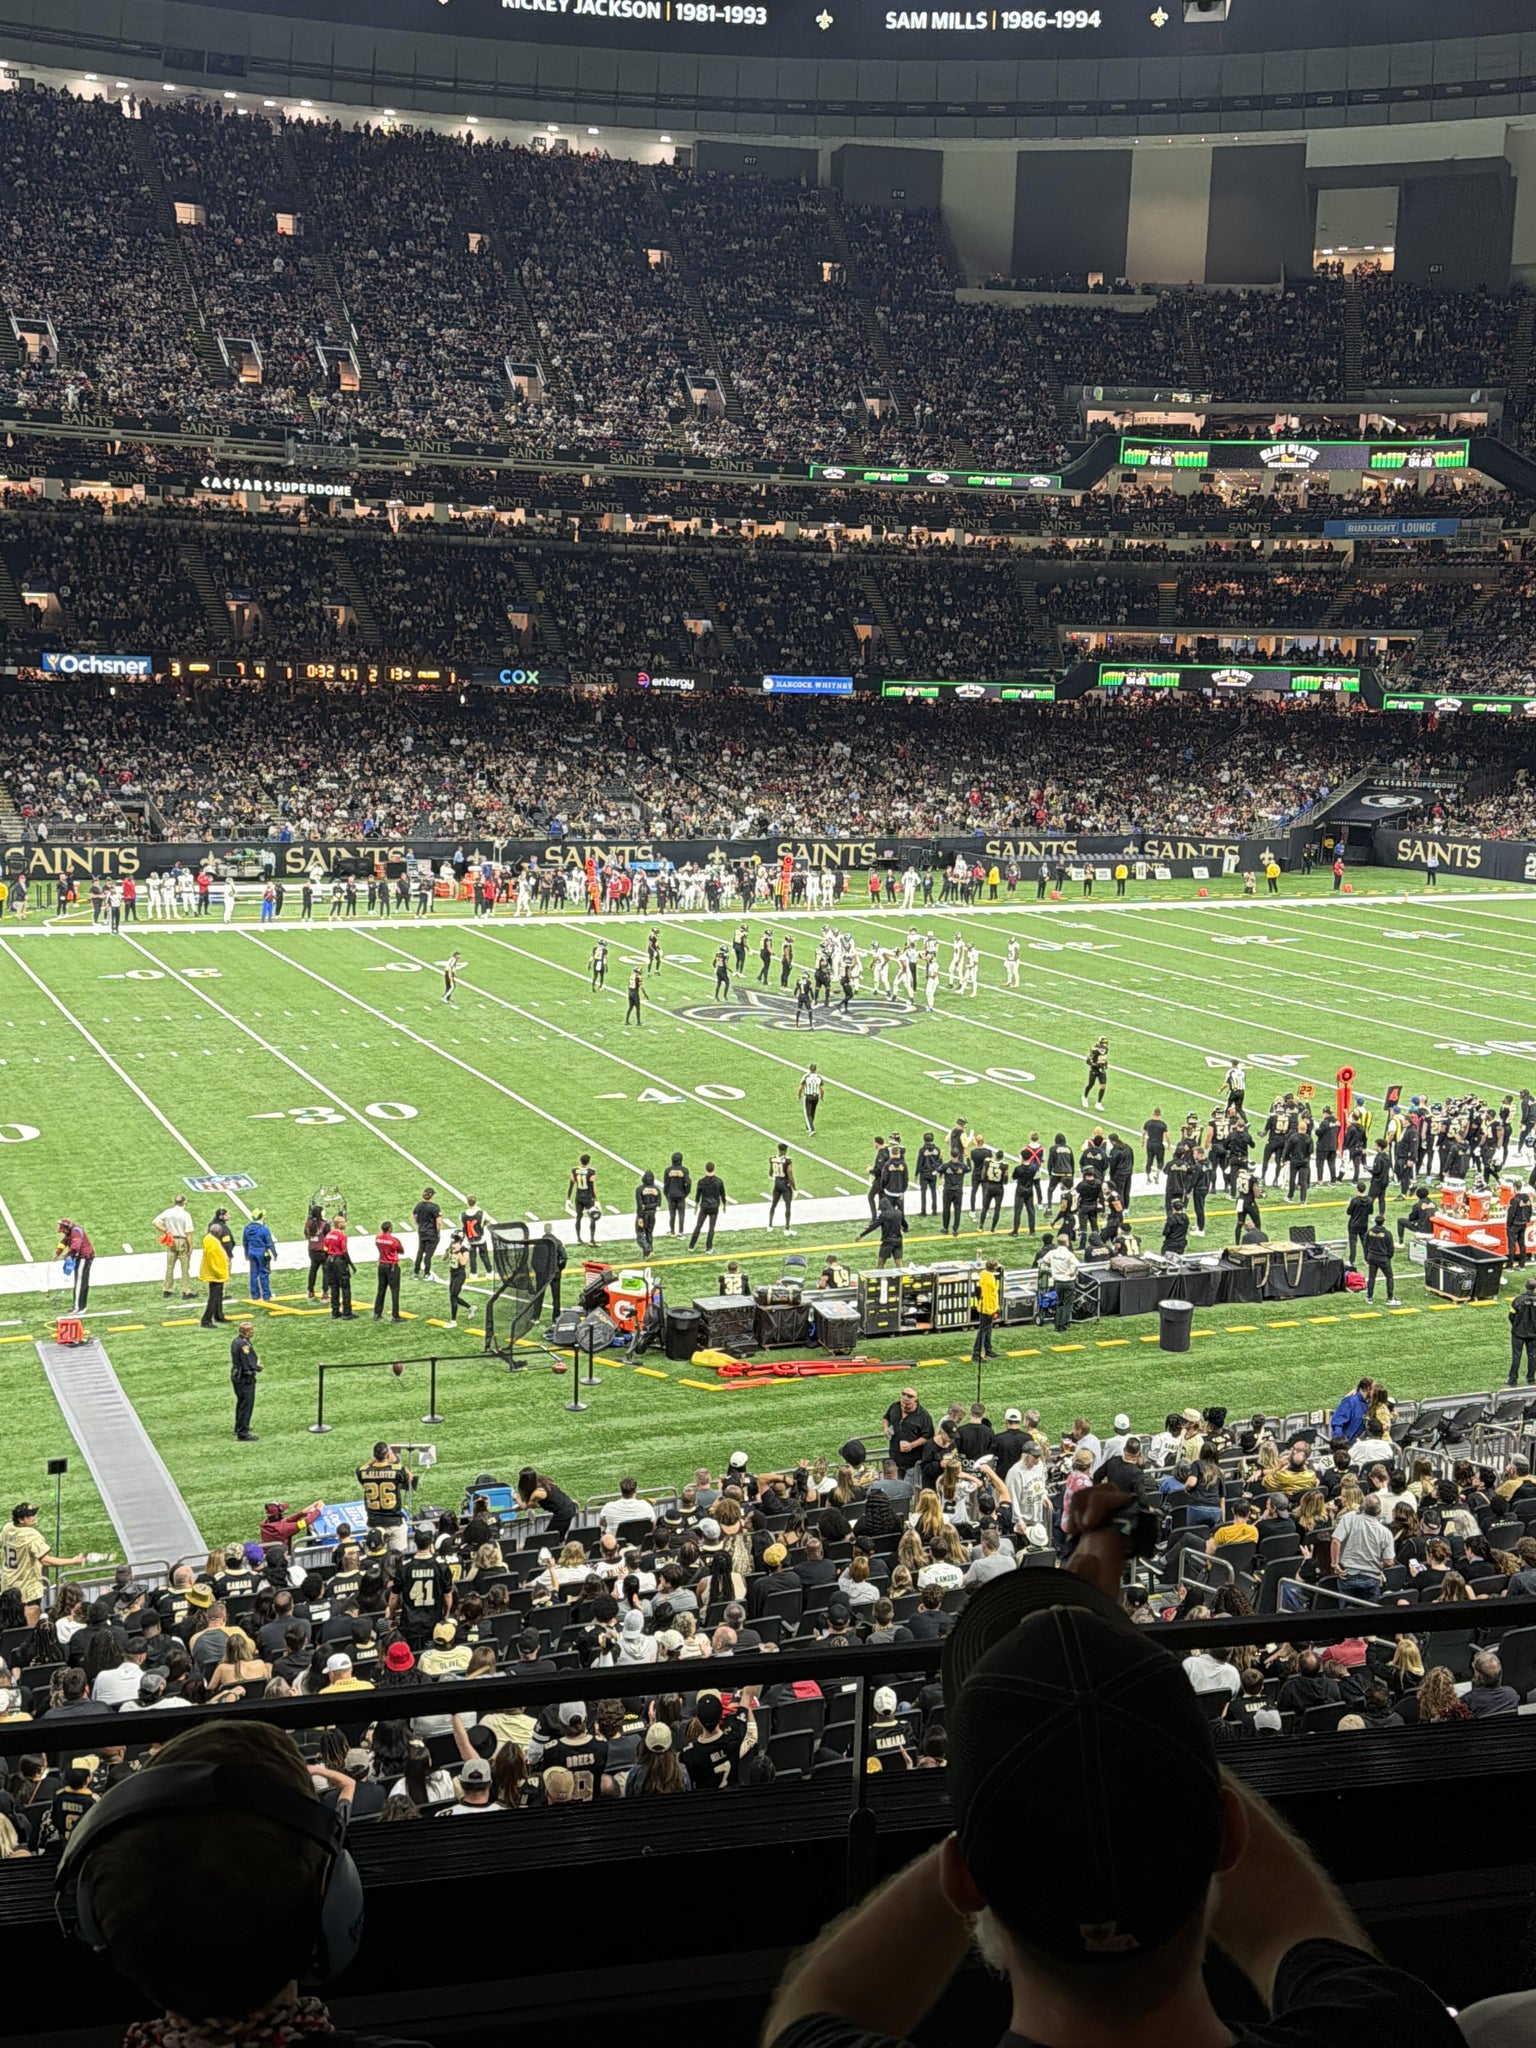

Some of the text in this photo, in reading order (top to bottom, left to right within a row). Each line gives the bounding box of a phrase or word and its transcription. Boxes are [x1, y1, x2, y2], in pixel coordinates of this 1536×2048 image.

[573, 0, 661, 19] JACKSON
[885, 10, 1102, 29] SAM MILLS 1986-1994
[62, 412, 114, 428] SAINTS
[180, 421, 231, 436] SAINTS
[403, 439, 451, 454] SAINTS
[508, 446, 555, 461] SAINTS
[609, 453, 655, 467] SAINTS
[709, 458, 755, 472] SAINTS
[107, 469, 157, 484] SAINTS
[201, 476, 352, 497] CAESARS SUPERDOME
[390, 488, 434, 503] SAINTS
[488, 494, 531, 508] SAINTS
[581, 500, 624, 514] SAINTS
[675, 504, 717, 518] SAINTS
[767, 510, 808, 521] SAINTS
[859, 513, 900, 525] SAINTS
[949, 517, 990, 529] SAINTS
[1040, 519, 1082, 531] SAINTS
[1133, 521, 1175, 532] SAINTS
[1228, 521, 1272, 533] SAINTS
[1347, 522, 1437, 533] BUD LIGHT LOUNGE
[59, 655, 148, 674] Ochsner
[499, 669, 539, 685] COX
[570, 672, 615, 684] SAINTS
[651, 677, 695, 690] entergy
[776, 681, 813, 689] HANCOCK
[1373, 779, 1458, 790] CAESARS SUPERDOME
[985, 840, 1077, 857] SAINTS
[1397, 838, 1482, 869] SAINTS
[923, 1067, 1036, 1085] 50
[637, 1084, 746, 1105] 40
[1388, 1087, 1399, 1102] 4
[288, 1102, 419, 1125] 30
[465, 1218, 479, 1239] K
[724, 1279, 742, 1295] 32
[614, 1299, 632, 1321] G
[59, 1322, 78, 1342] 20
[363, 1482, 397, 1510] 26
[3, 1546, 19, 1569] 12
[935, 1573, 958, 1583] KAMARA
[333, 1581, 359, 1593] KAMARA
[409, 1579, 435, 1607] 41
[876, 1733, 906, 1750] KAMARA
[565, 1753, 595, 1768] BREES
[709, 1750, 727, 1763] HILL
[713, 1760, 731, 1789] 7
[62, 1801, 83, 1813] BREES
